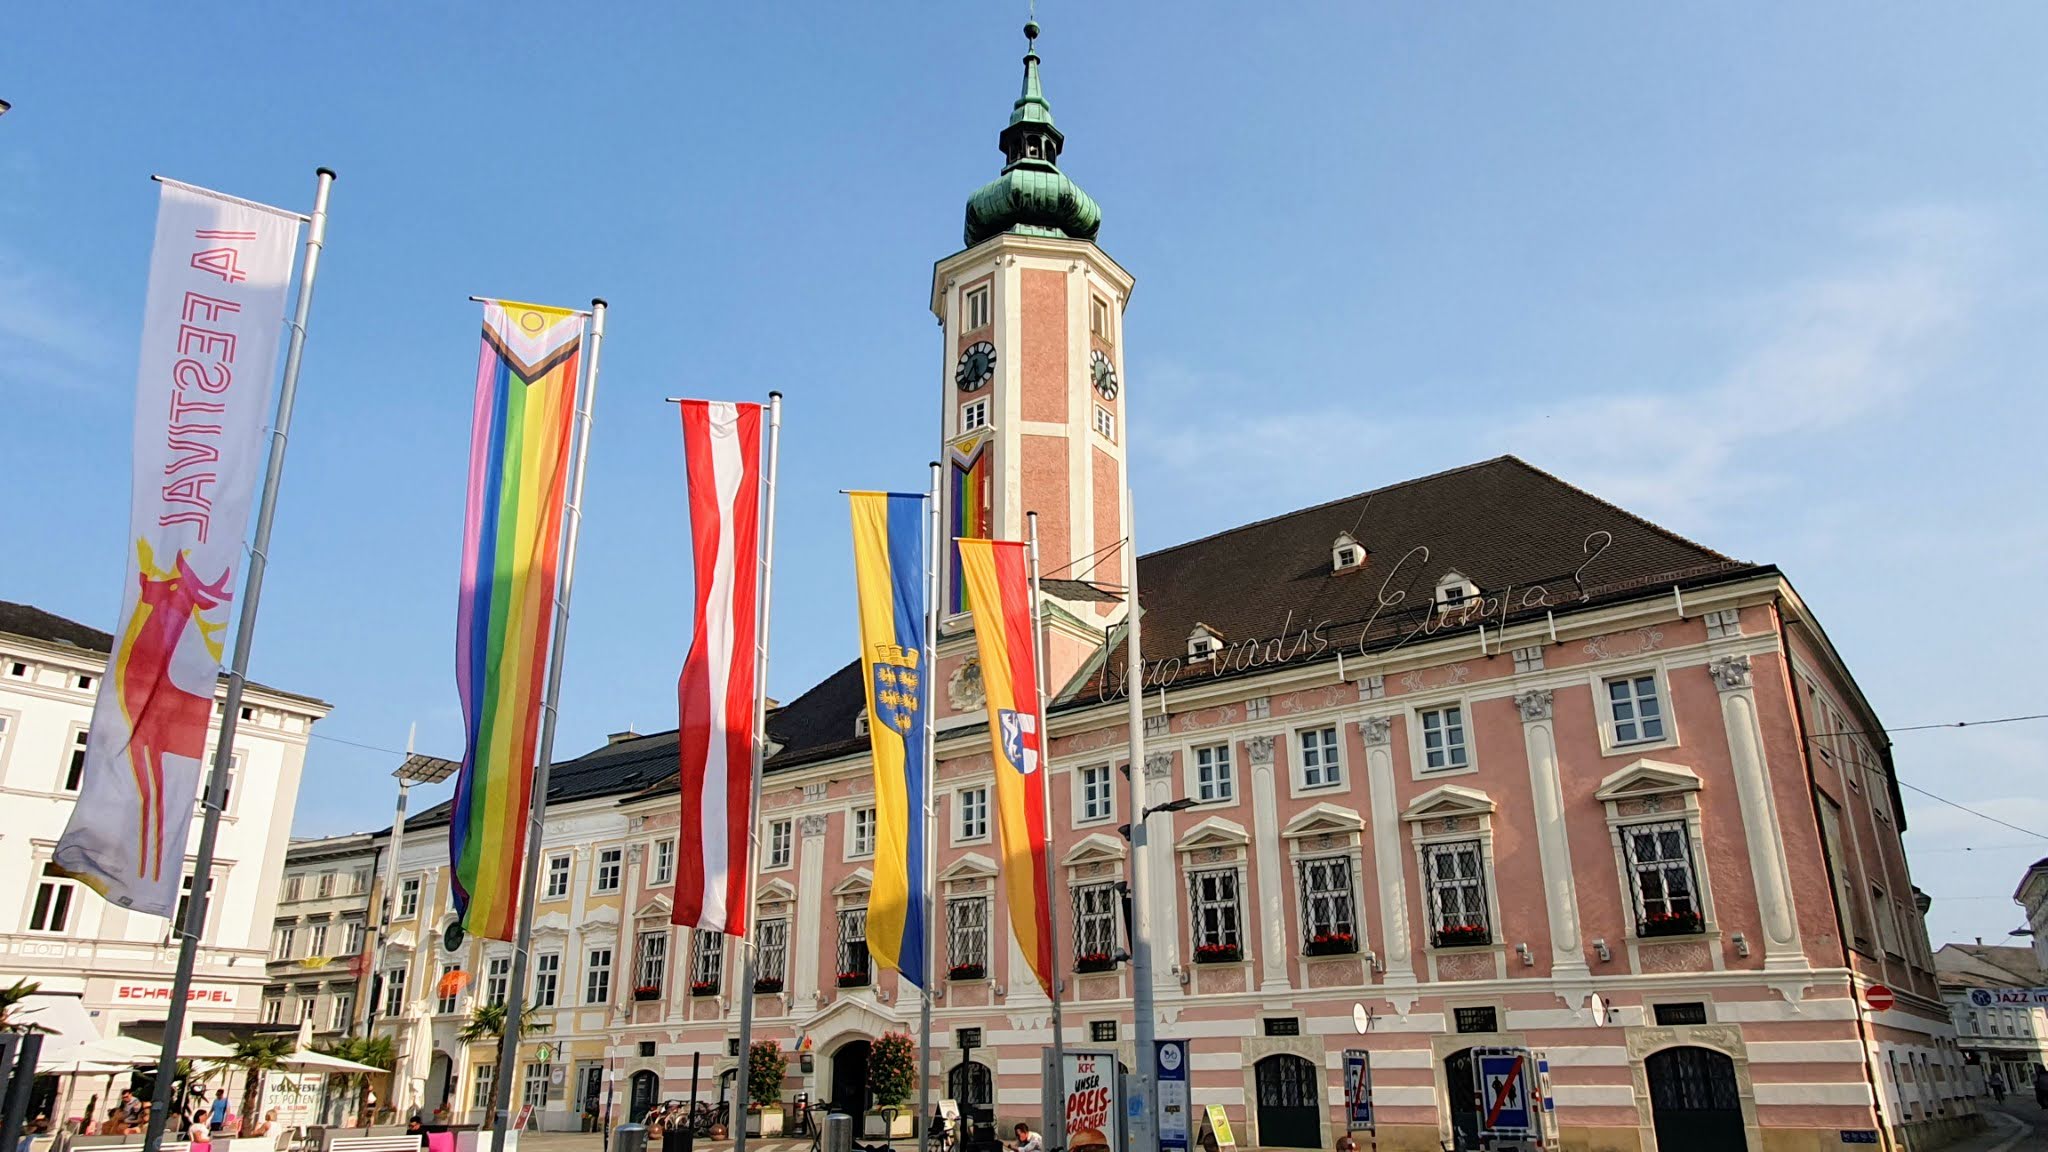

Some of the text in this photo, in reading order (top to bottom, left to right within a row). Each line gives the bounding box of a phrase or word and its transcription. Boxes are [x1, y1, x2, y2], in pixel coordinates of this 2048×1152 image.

[1213, 609, 1332, 678] vadis
[1995, 993, 2030, 1003] JAZZ
[1078, 1063, 1096, 1073] KFC
[271, 1084, 316, 1092] VOLKFEST
[1075, 1075, 1099, 1092] UNSER
[1066, 1086, 1112, 1120] PREIS-
